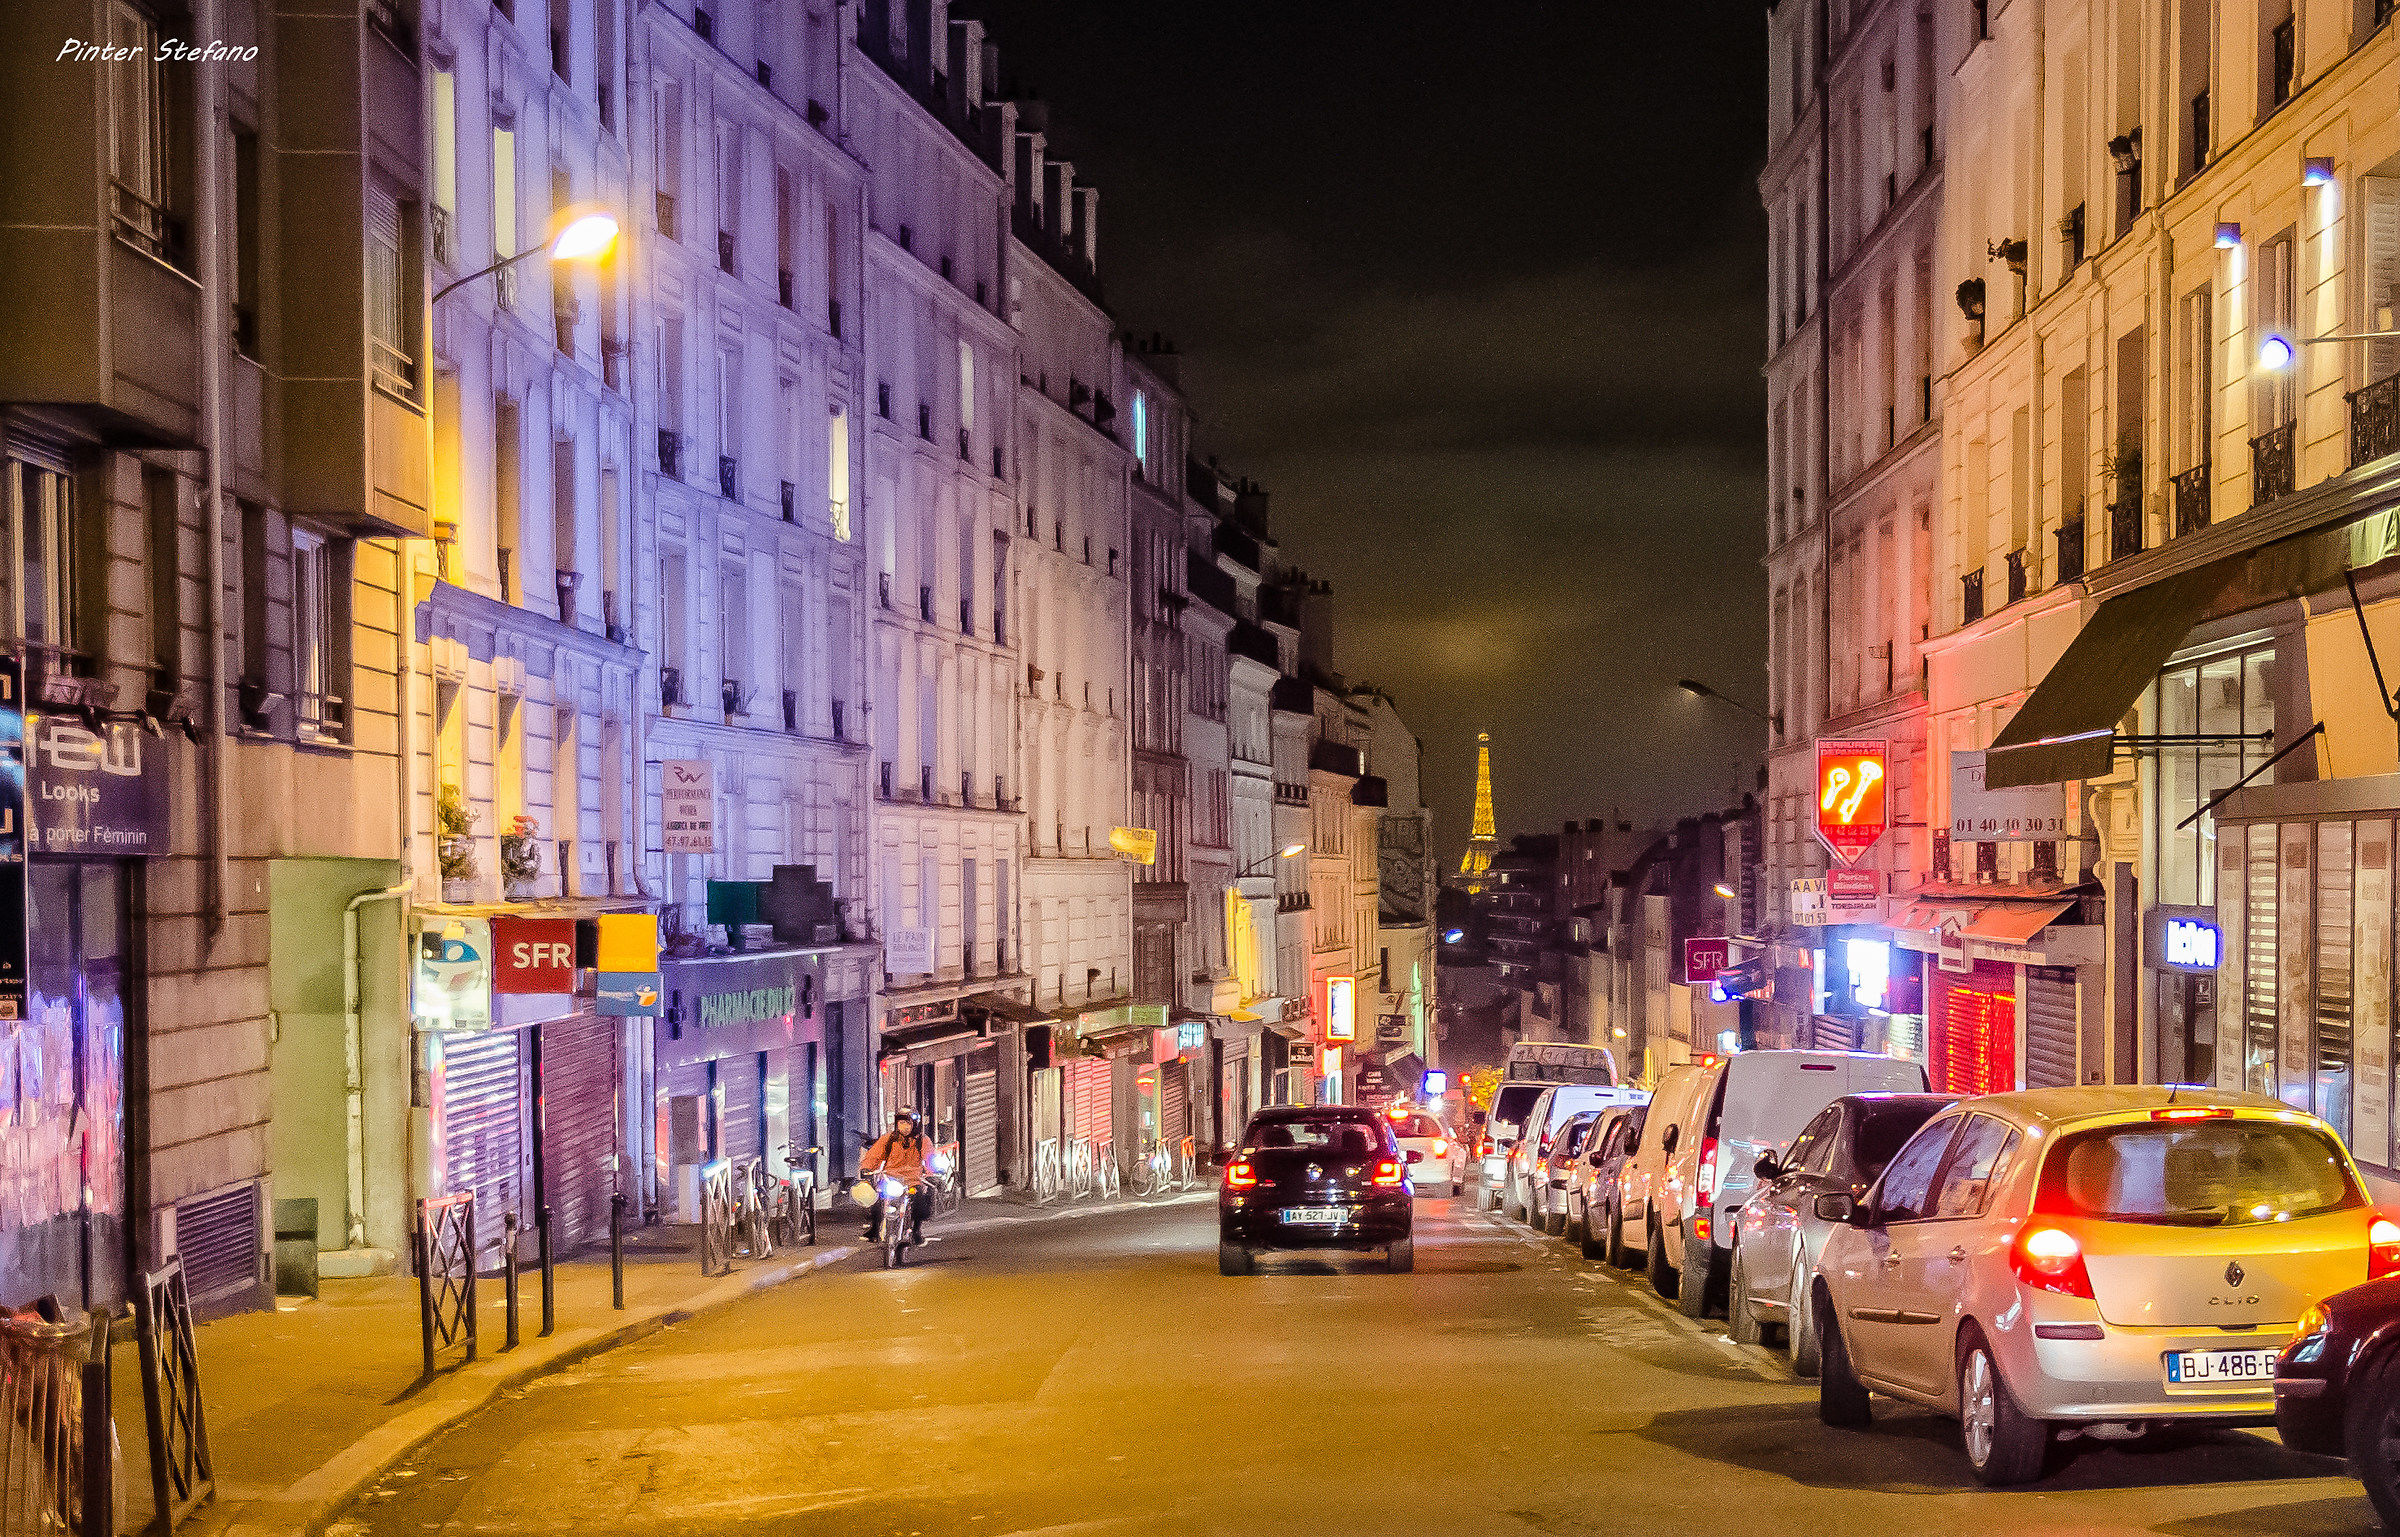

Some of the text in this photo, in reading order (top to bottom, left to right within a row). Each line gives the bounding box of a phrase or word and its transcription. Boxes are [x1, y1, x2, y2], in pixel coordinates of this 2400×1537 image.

[42, 781, 100, 802] Looks
[1956, 818, 1973, 832] 01
[1979, 818, 1997, 832] 40
[2025, 818, 2043, 832] 30
[2047, 817, 2064, 832] 31
[93, 826, 147, 846] Féminin
[512, 942, 572, 969] SFR
[1693, 951, 1724, 970] SFR
[2209, 1297, 2259, 1305] CLIO
